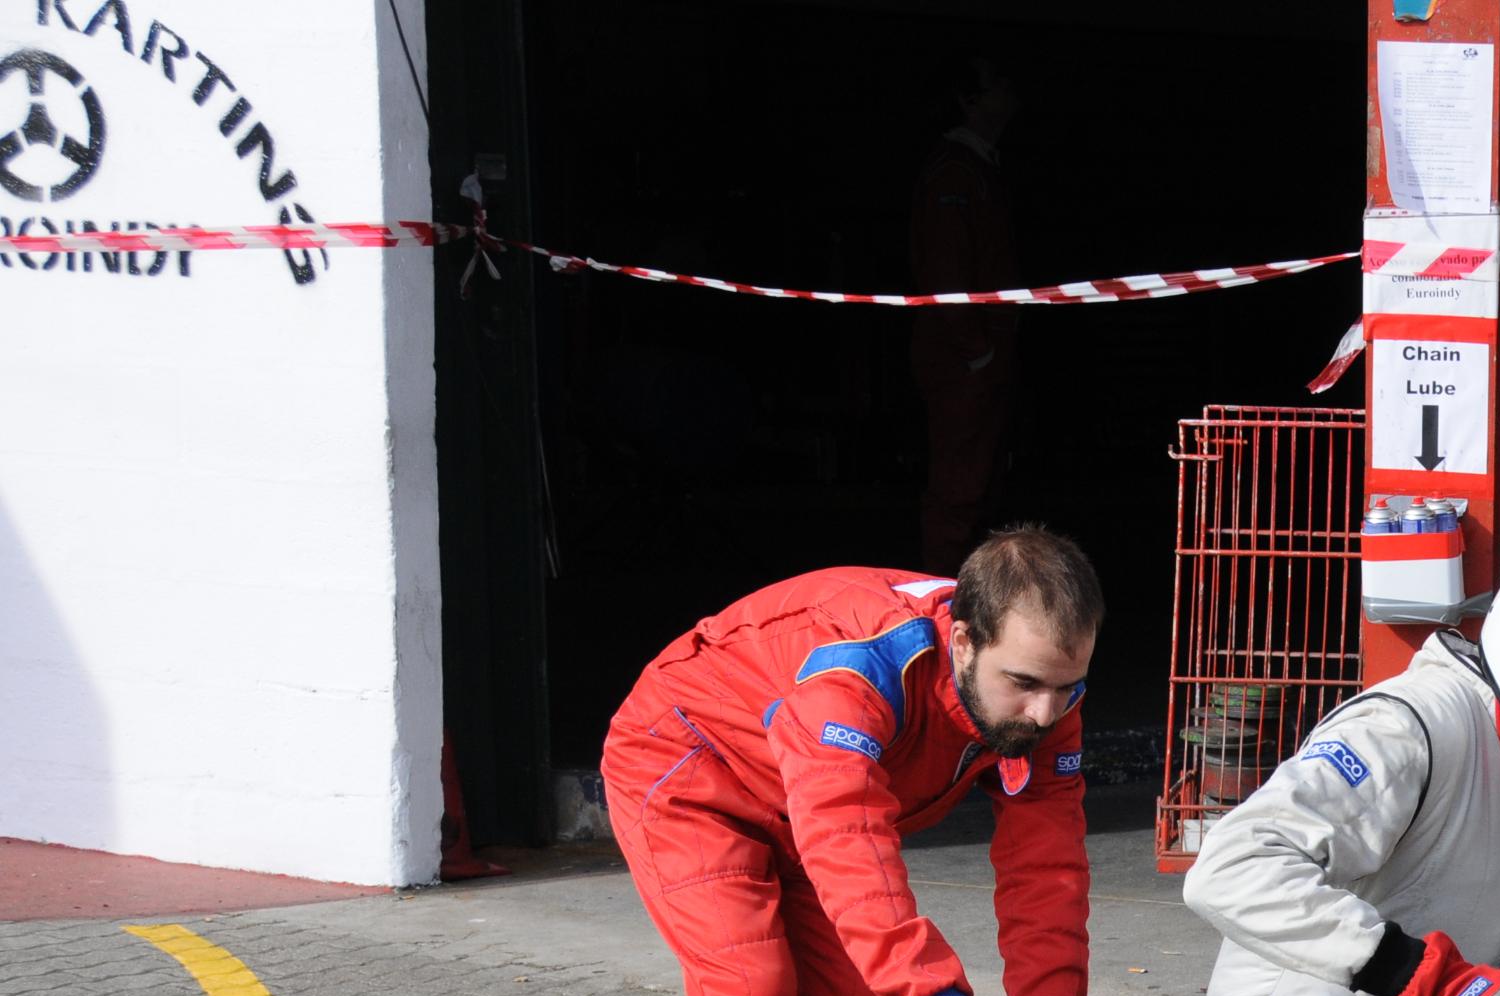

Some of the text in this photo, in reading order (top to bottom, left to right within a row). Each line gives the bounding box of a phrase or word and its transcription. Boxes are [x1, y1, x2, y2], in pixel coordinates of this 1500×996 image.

[1406, 288, 1462, 301] Euroindy
[1403, 346, 1461, 362] Chain
[1406, 380, 1456, 396] Lube
[824, 725, 881, 759] sparco
